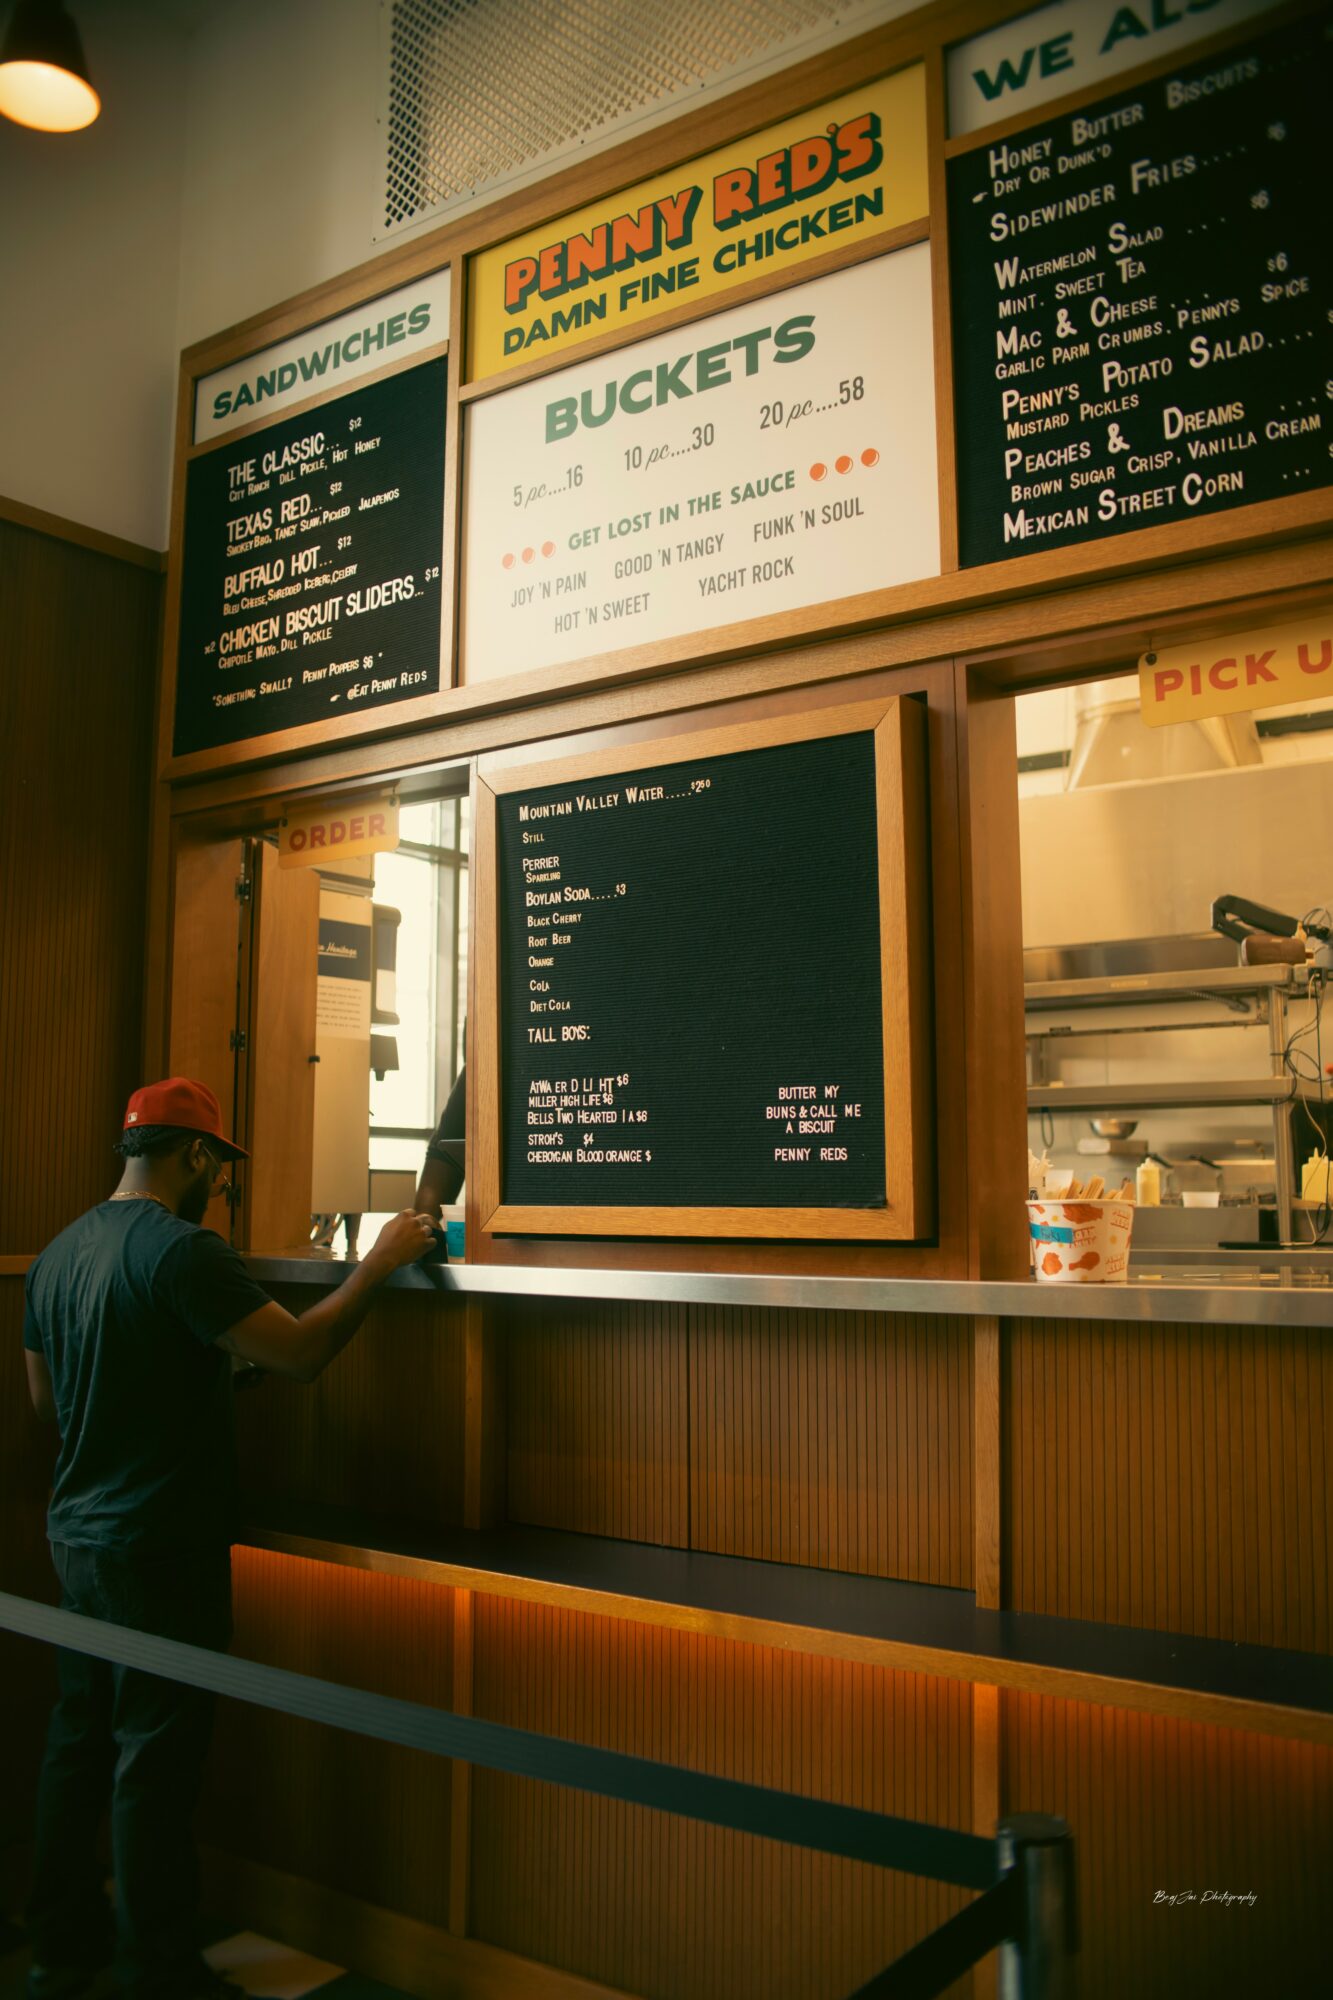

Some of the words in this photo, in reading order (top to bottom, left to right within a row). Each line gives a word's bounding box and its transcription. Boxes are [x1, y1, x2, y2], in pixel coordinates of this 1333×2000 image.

[972, 31, 1075, 102] WE
[989, 138, 1052, 179] HONEY
[1071, 104, 1144, 147] BUTTER
[1167, 58, 1258, 110] BISCUITS
[993, 177, 1021, 198] DRY
[1029, 165, 1051, 184] OR
[504, 184, 703, 314] PENNY
[713, 112, 883, 232] RED'S
[990, 184, 1116, 242] SIDEWINDER
[503, 293, 607, 356] DAMN
[619, 257, 700, 312] FINE
[712, 186, 884, 274] CHICKEN
[994, 246, 1096, 291] WATERMELON
[1108, 222, 1163, 255] SALAD
[1267, 252, 1288, 272] $6
[1055, 272, 1106, 300] SWEET
[1116, 257, 1147, 285] TEA
[995, 355, 1046, 380] GARLIC
[1052, 342, 1090, 366] PARM
[1176, 298, 1240, 329] PENNYS
[1261, 277, 1310, 303] SPICE
[996, 325, 1042, 360] MAC
[1055, 308, 1078, 338] &
[1090, 295, 1158, 328] CHEESE
[212, 303, 431, 419] SANDWICHES
[545, 314, 816, 444] BUCKETS
[1002, 383, 1080, 421] PENNY'S
[1102, 357, 1173, 393] POTATO
[1006, 412, 1069, 441] MUSTARD
[1079, 394, 1139, 422] PICKLES
[333, 449, 348, 464] HOT
[355, 437, 381, 455] HONEY
[1004, 441, 1091, 479] PEACHES
[1107, 422, 1131, 454] &
[1163, 401, 1245, 441] DREAMS
[228, 458, 256, 488] THE
[1011, 477, 1062, 503] BROWN
[1070, 465, 1116, 489] SUGAR
[1188, 431, 1258, 460] VANILLA
[1265, 414, 1322, 441] CREAM
[568, 526, 600, 551] GET
[607, 511, 652, 540] LOST
[659, 503, 680, 525] IN
[687, 491, 721, 517] THE
[730, 470, 796, 505] SAUCE
[753, 515, 795, 543] FUNK
[821, 496, 864, 525] SOUL
[1003, 505, 1089, 543] MEXICAN
[1098, 485, 1176, 522] STREET
[1182, 471, 1244, 506] CORN
[226, 508, 273, 543] TEXAS
[274, 524, 298, 541] TANGY
[224, 558, 285, 599] BUFFALO
[337, 535, 352, 551] $12
[614, 554, 653, 579] GOOD
[676, 533, 725, 562] TANGY
[511, 587, 534, 608] JOY
[556, 571, 587, 596] PAIN
[698, 569, 748, 597] YACHT
[752, 555, 795, 583] ROCK
[219, 615, 280, 655] CHICKEN
[286, 596, 344, 635] BISCUIT
[424, 566, 439, 582] $12
[554, 612, 580, 634] HOT
[603, 592, 651, 621] SWEET
[281, 638, 298, 652] DILL
[303, 626, 333, 645] PICKLE
[303, 669, 327, 684] PENNY
[329, 659, 359, 676] POPPERS
[362, 655, 374, 670] $6
[371, 676, 397, 693] PENNY
[400, 670, 428, 687] REDS
[1154, 649, 1280, 702] PICK
[519, 801, 573, 822] MOUNTAIN
[576, 793, 619, 813] VALLEY
[289, 813, 386, 851] ORDER
[522, 832, 545, 844] STILL
[522, 856, 560, 872] PERRIER
[525, 871, 561, 884] SPARKLING
[525, 890, 562, 907] BOYLAN
[527, 915, 550, 928] BLACK
[552, 912, 582, 925] CHERRY
[528, 936, 548, 948] ROOT
[552, 933, 572, 946] BEER
[528, 955, 554, 968] ORANGE
[529, 980, 550, 992] COLA
[530, 1001, 547, 1013] DIET
[548, 999, 571, 1012] COLA
[528, 1028, 557, 1044] TALL
[616, 1073, 629, 1087] $6
[779, 1086, 817, 1100] BUTTER
[824, 1085, 840, 1099] MY
[527, 1111, 554, 1125] BELLS
[555, 1107, 574, 1124] TWO
[577, 1110, 617, 1124] HEARTED
[528, 1096, 557, 1108] MILLER
[560, 1095, 580, 1107] HIGH
[582, 1094, 601, 1106] LIFE
[602, 1092, 614, 1105] $6
[766, 1106, 796, 1119] BUNS
[799, 1105, 808, 1118] &
[810, 1105, 838, 1118] CALL
[845, 1104, 861, 1117] ME
[786, 1121, 793, 1134] A
[799, 1120, 835, 1134] BISCUIT
[576, 1148, 604, 1163] BLOOD
[605, 1150, 642, 1163] ORANGE
[774, 1148, 811, 1161] PENNY
[820, 1148, 848, 1161] REDS
